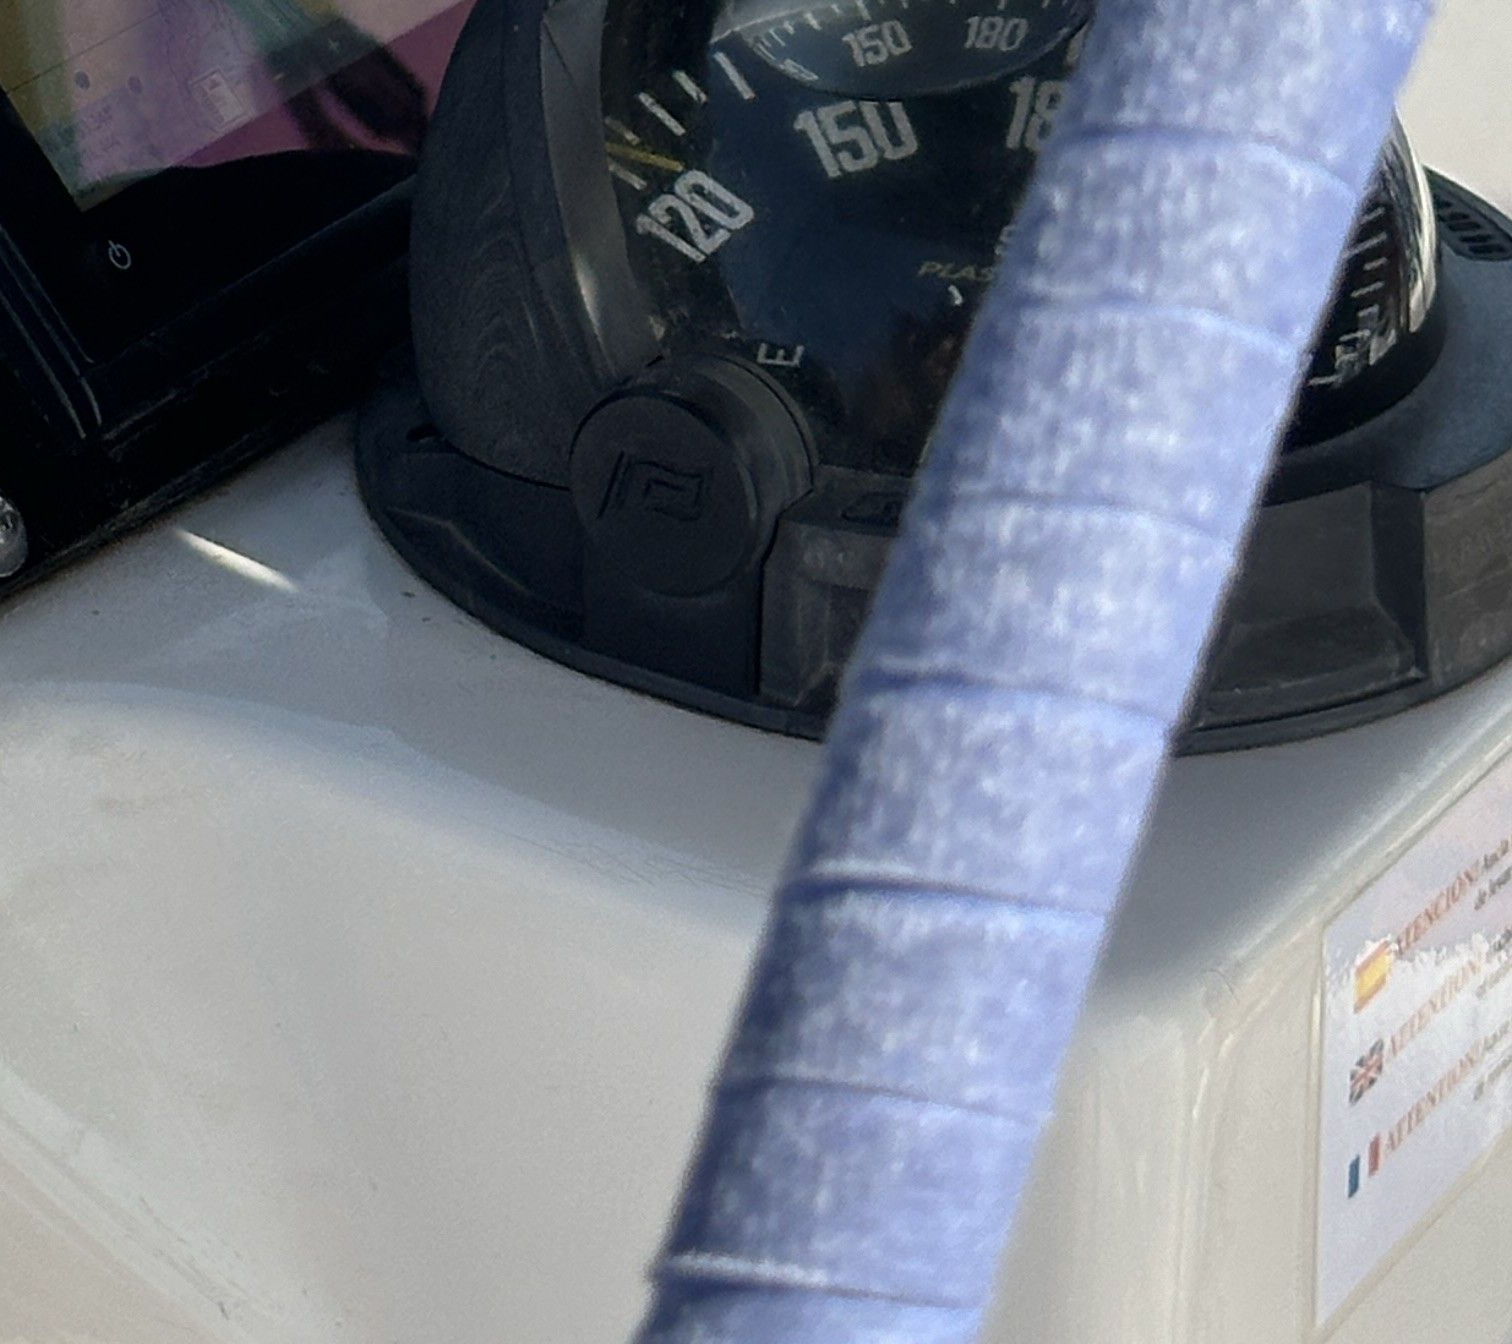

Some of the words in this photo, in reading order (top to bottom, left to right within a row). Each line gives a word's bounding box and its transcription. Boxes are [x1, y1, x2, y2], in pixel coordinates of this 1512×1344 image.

[842, 19, 913, 67] 150
[965, 14, 1029, 52] 180
[636, 168, 755, 263] 120
